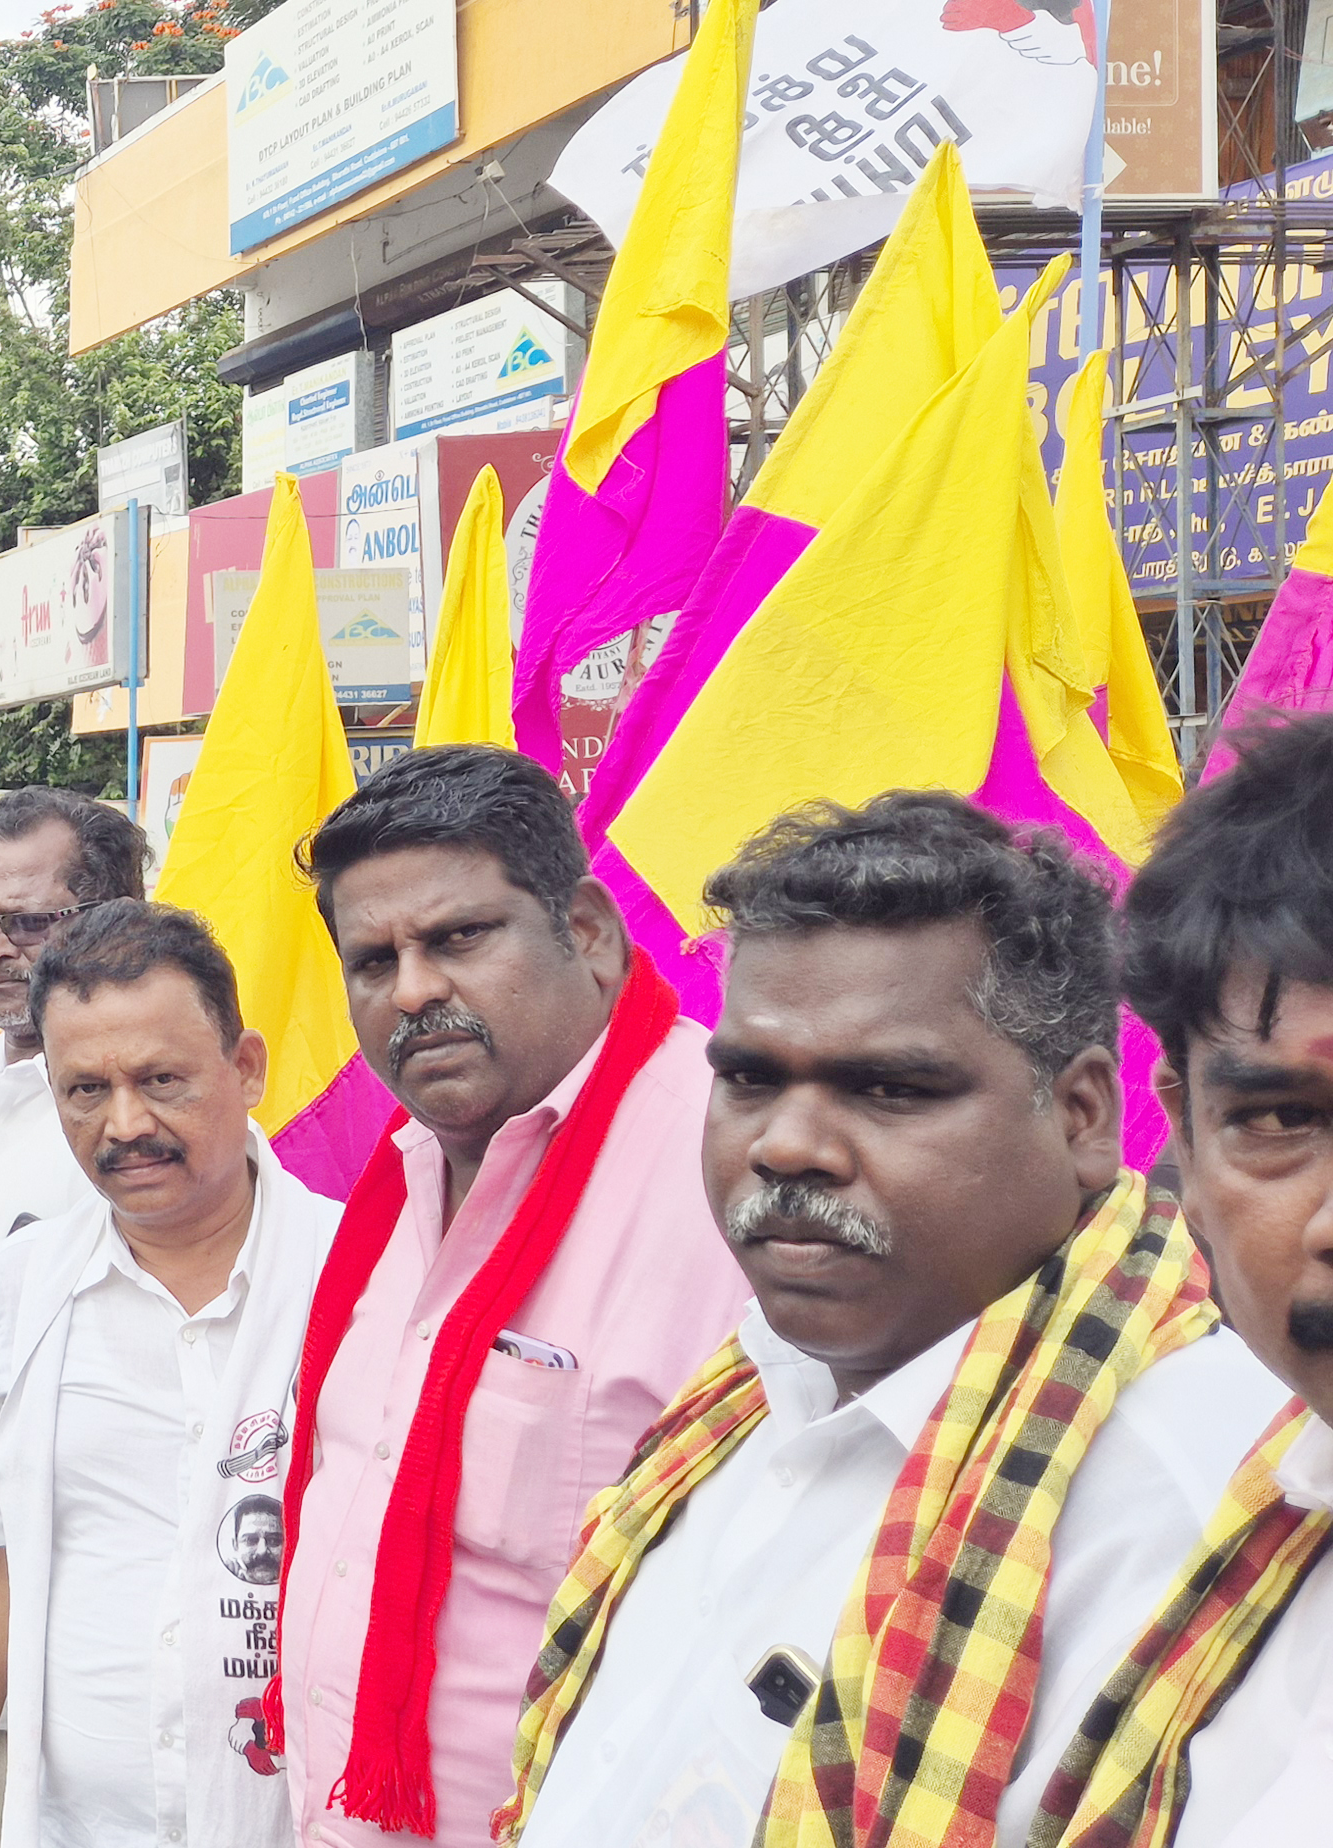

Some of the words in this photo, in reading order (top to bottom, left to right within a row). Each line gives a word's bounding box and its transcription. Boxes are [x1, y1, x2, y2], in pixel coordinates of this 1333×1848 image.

[280, 122, 309, 149] LAYOUT
[311, 108, 333, 129] PLAN
[343, 78, 385, 111] BUILDING
[388, 61, 412, 84] PLAN
[362, 522, 419, 563] ANBOL
[21, 585, 51, 648] Arun
[316, 594, 356, 603] PPROVAL
[358, 593, 380, 602] PLAN
